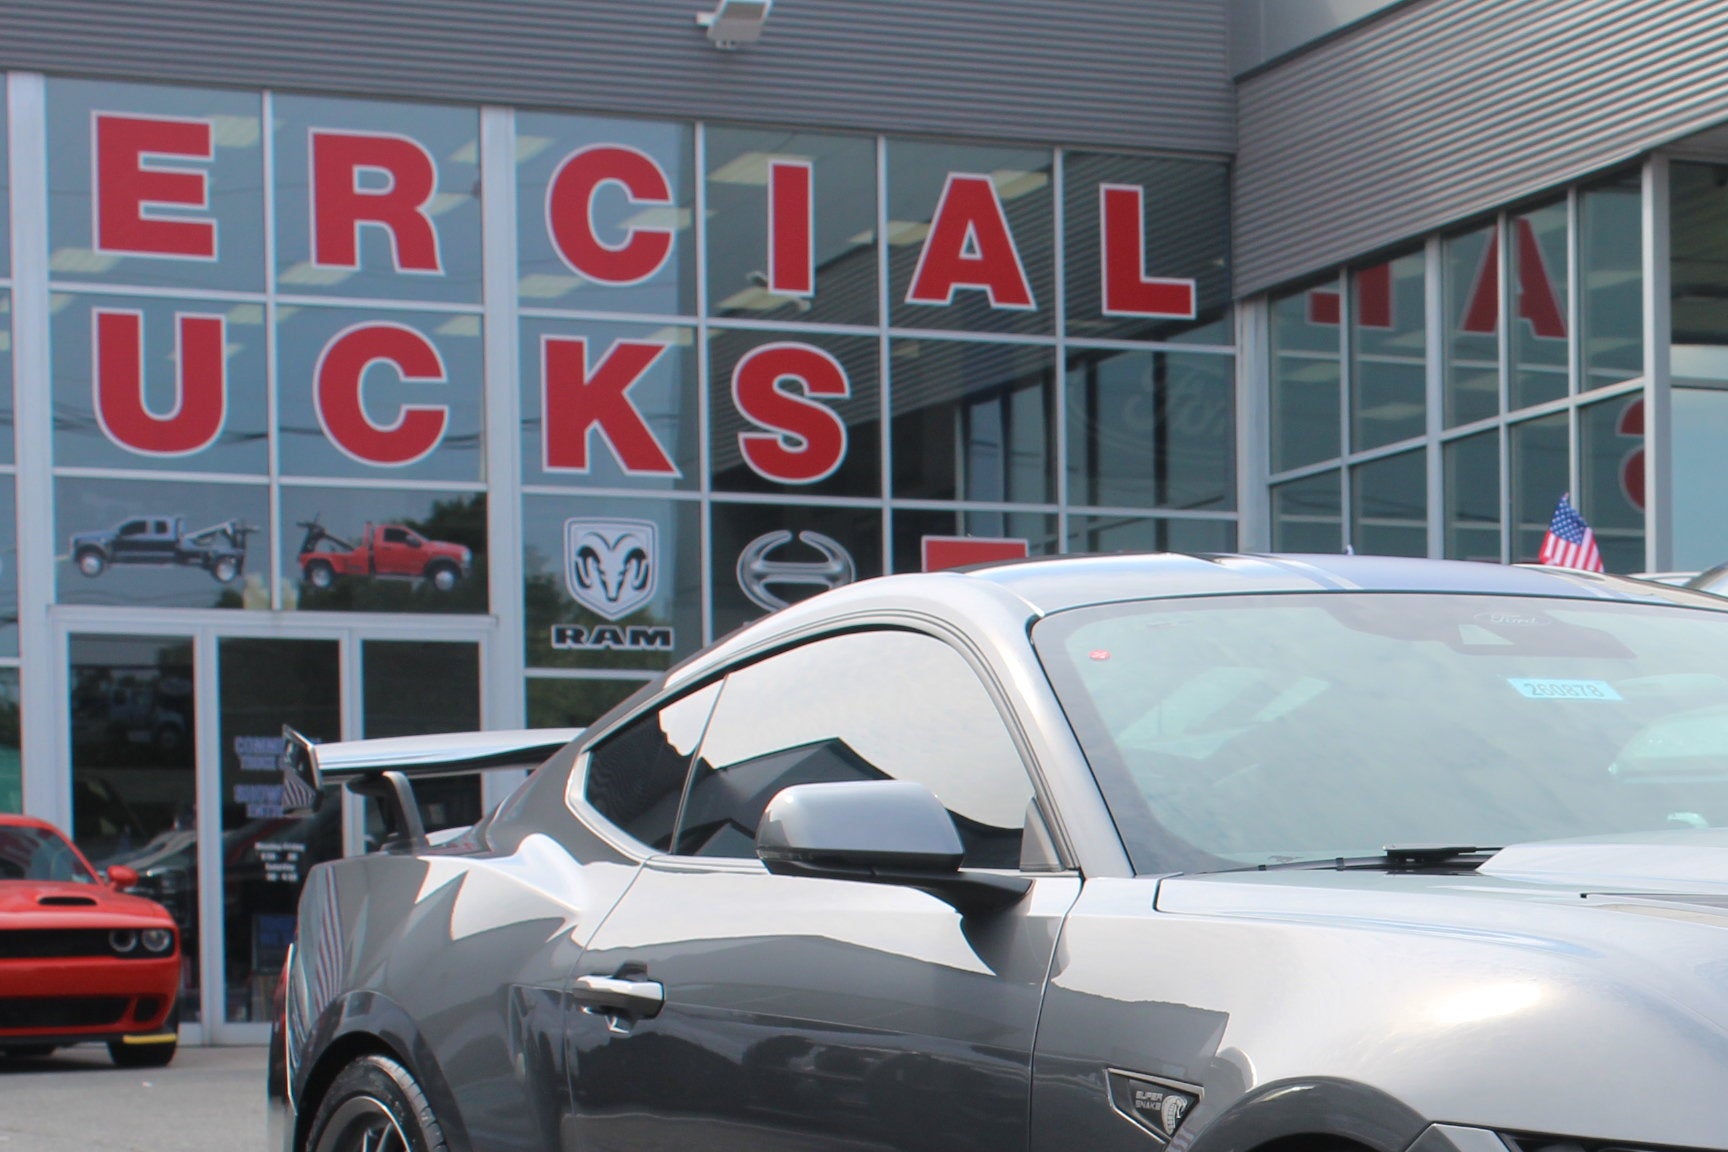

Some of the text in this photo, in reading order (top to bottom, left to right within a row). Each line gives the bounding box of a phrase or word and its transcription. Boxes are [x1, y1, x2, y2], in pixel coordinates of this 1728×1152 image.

[551, 625, 674, 650] RAM
[1523, 682, 1605, 698] 260878
[1135, 1090, 1163, 1101] SUPER
[1135, 1100, 1162, 1111] SNAKE
